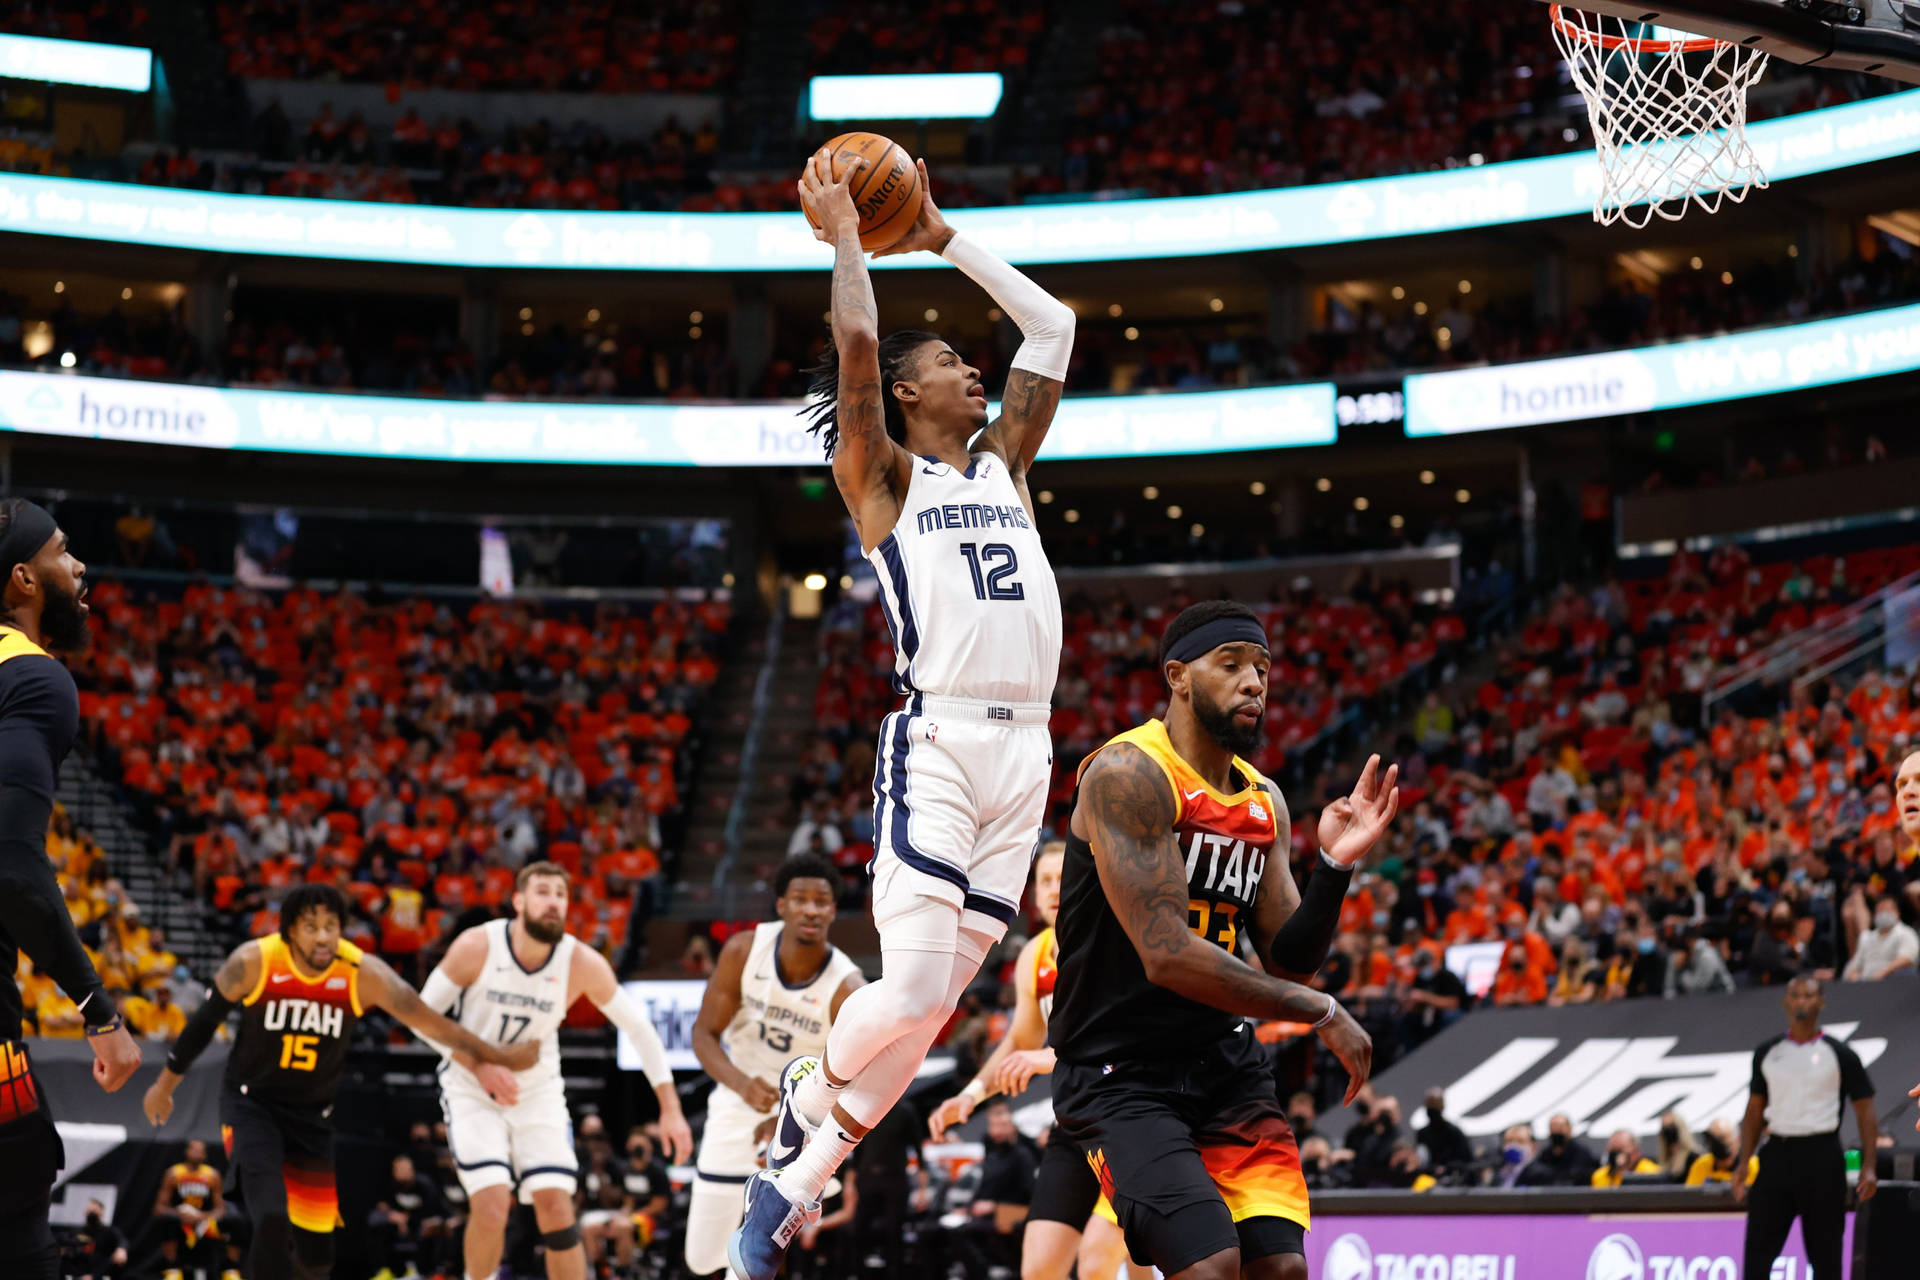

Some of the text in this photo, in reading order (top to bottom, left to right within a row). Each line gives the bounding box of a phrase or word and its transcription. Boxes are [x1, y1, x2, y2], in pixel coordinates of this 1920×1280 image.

[1383, 170, 1528, 231] homie
[563, 216, 712, 265] homie
[1785, 330, 1849, 384] got
[1853, 325, 1920, 373] you
[1501, 368, 1625, 415] homie
[79, 391, 207, 437] homie
[379, 410, 446, 452] got
[917, 504, 1029, 535] MEMPHIS
[959, 542, 1026, 601] 12
[263, 998, 344, 1039] UTAH
[498, 1013, 532, 1044] 17
[758, 1020, 794, 1054] 13
[279, 1033, 321, 1072] 15
[1375, 1253, 1450, 1280] TACO
[1648, 1254, 1738, 1280] TACO
